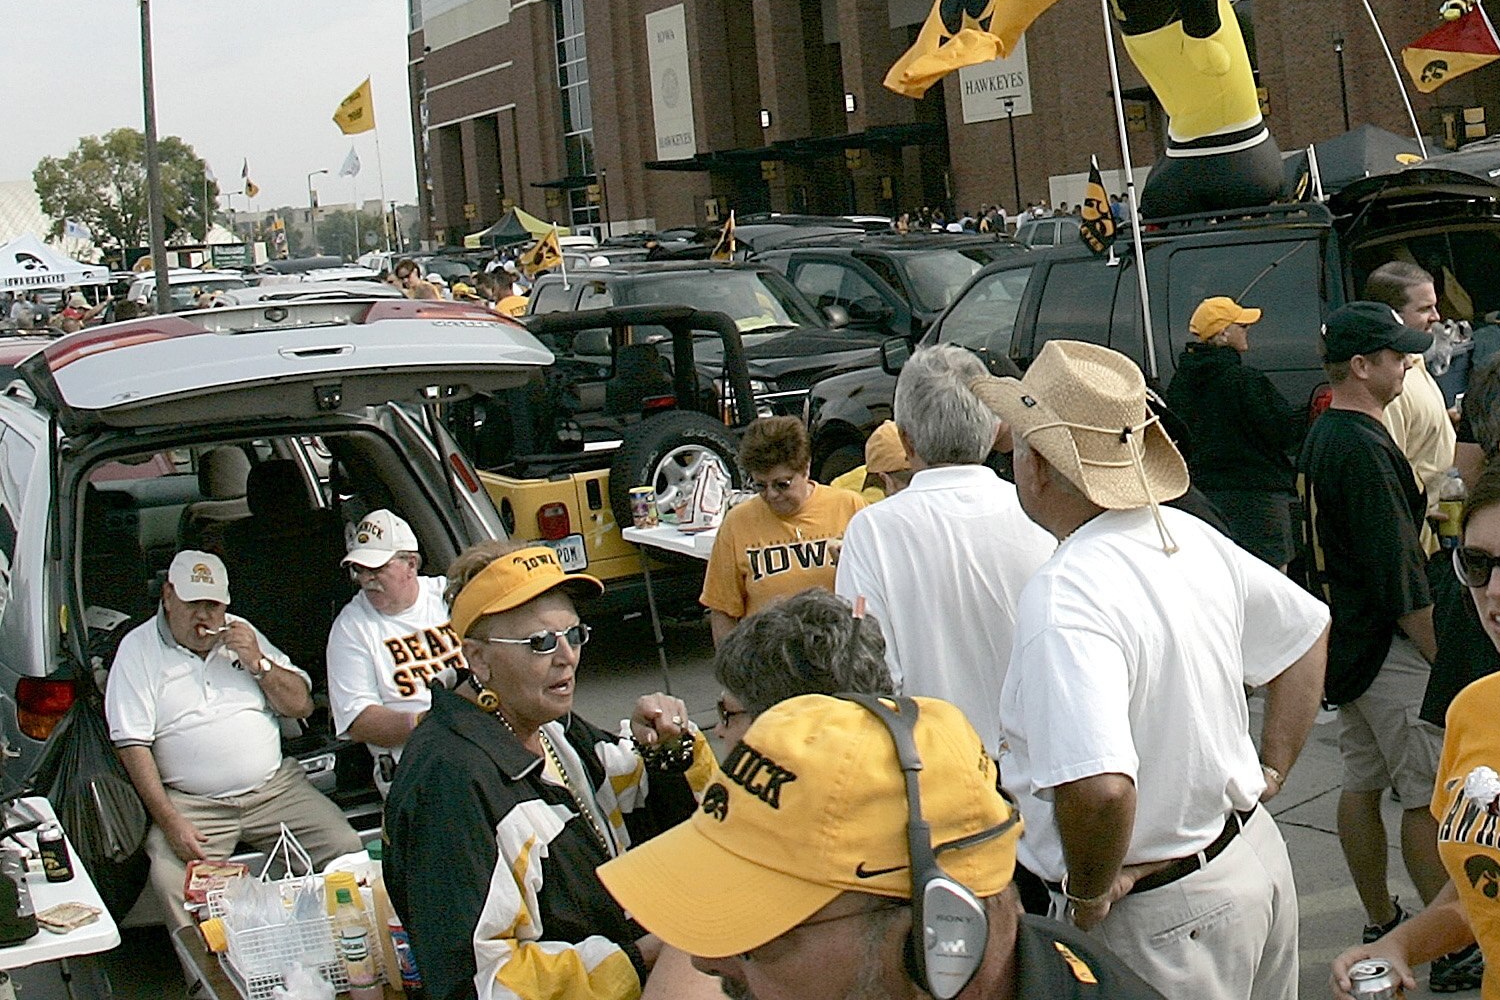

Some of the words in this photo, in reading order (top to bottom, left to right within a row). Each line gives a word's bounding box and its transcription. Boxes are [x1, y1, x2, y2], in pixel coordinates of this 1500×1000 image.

[965, 71, 1025, 96] HAWKEYES
[4, 277, 24, 287] IOWA
[25, 273, 65, 285] HAWKEYES
[746, 539, 838, 581] IOW
[384, 623, 463, 666] BEAT
[935, 914, 973, 923] SONY
